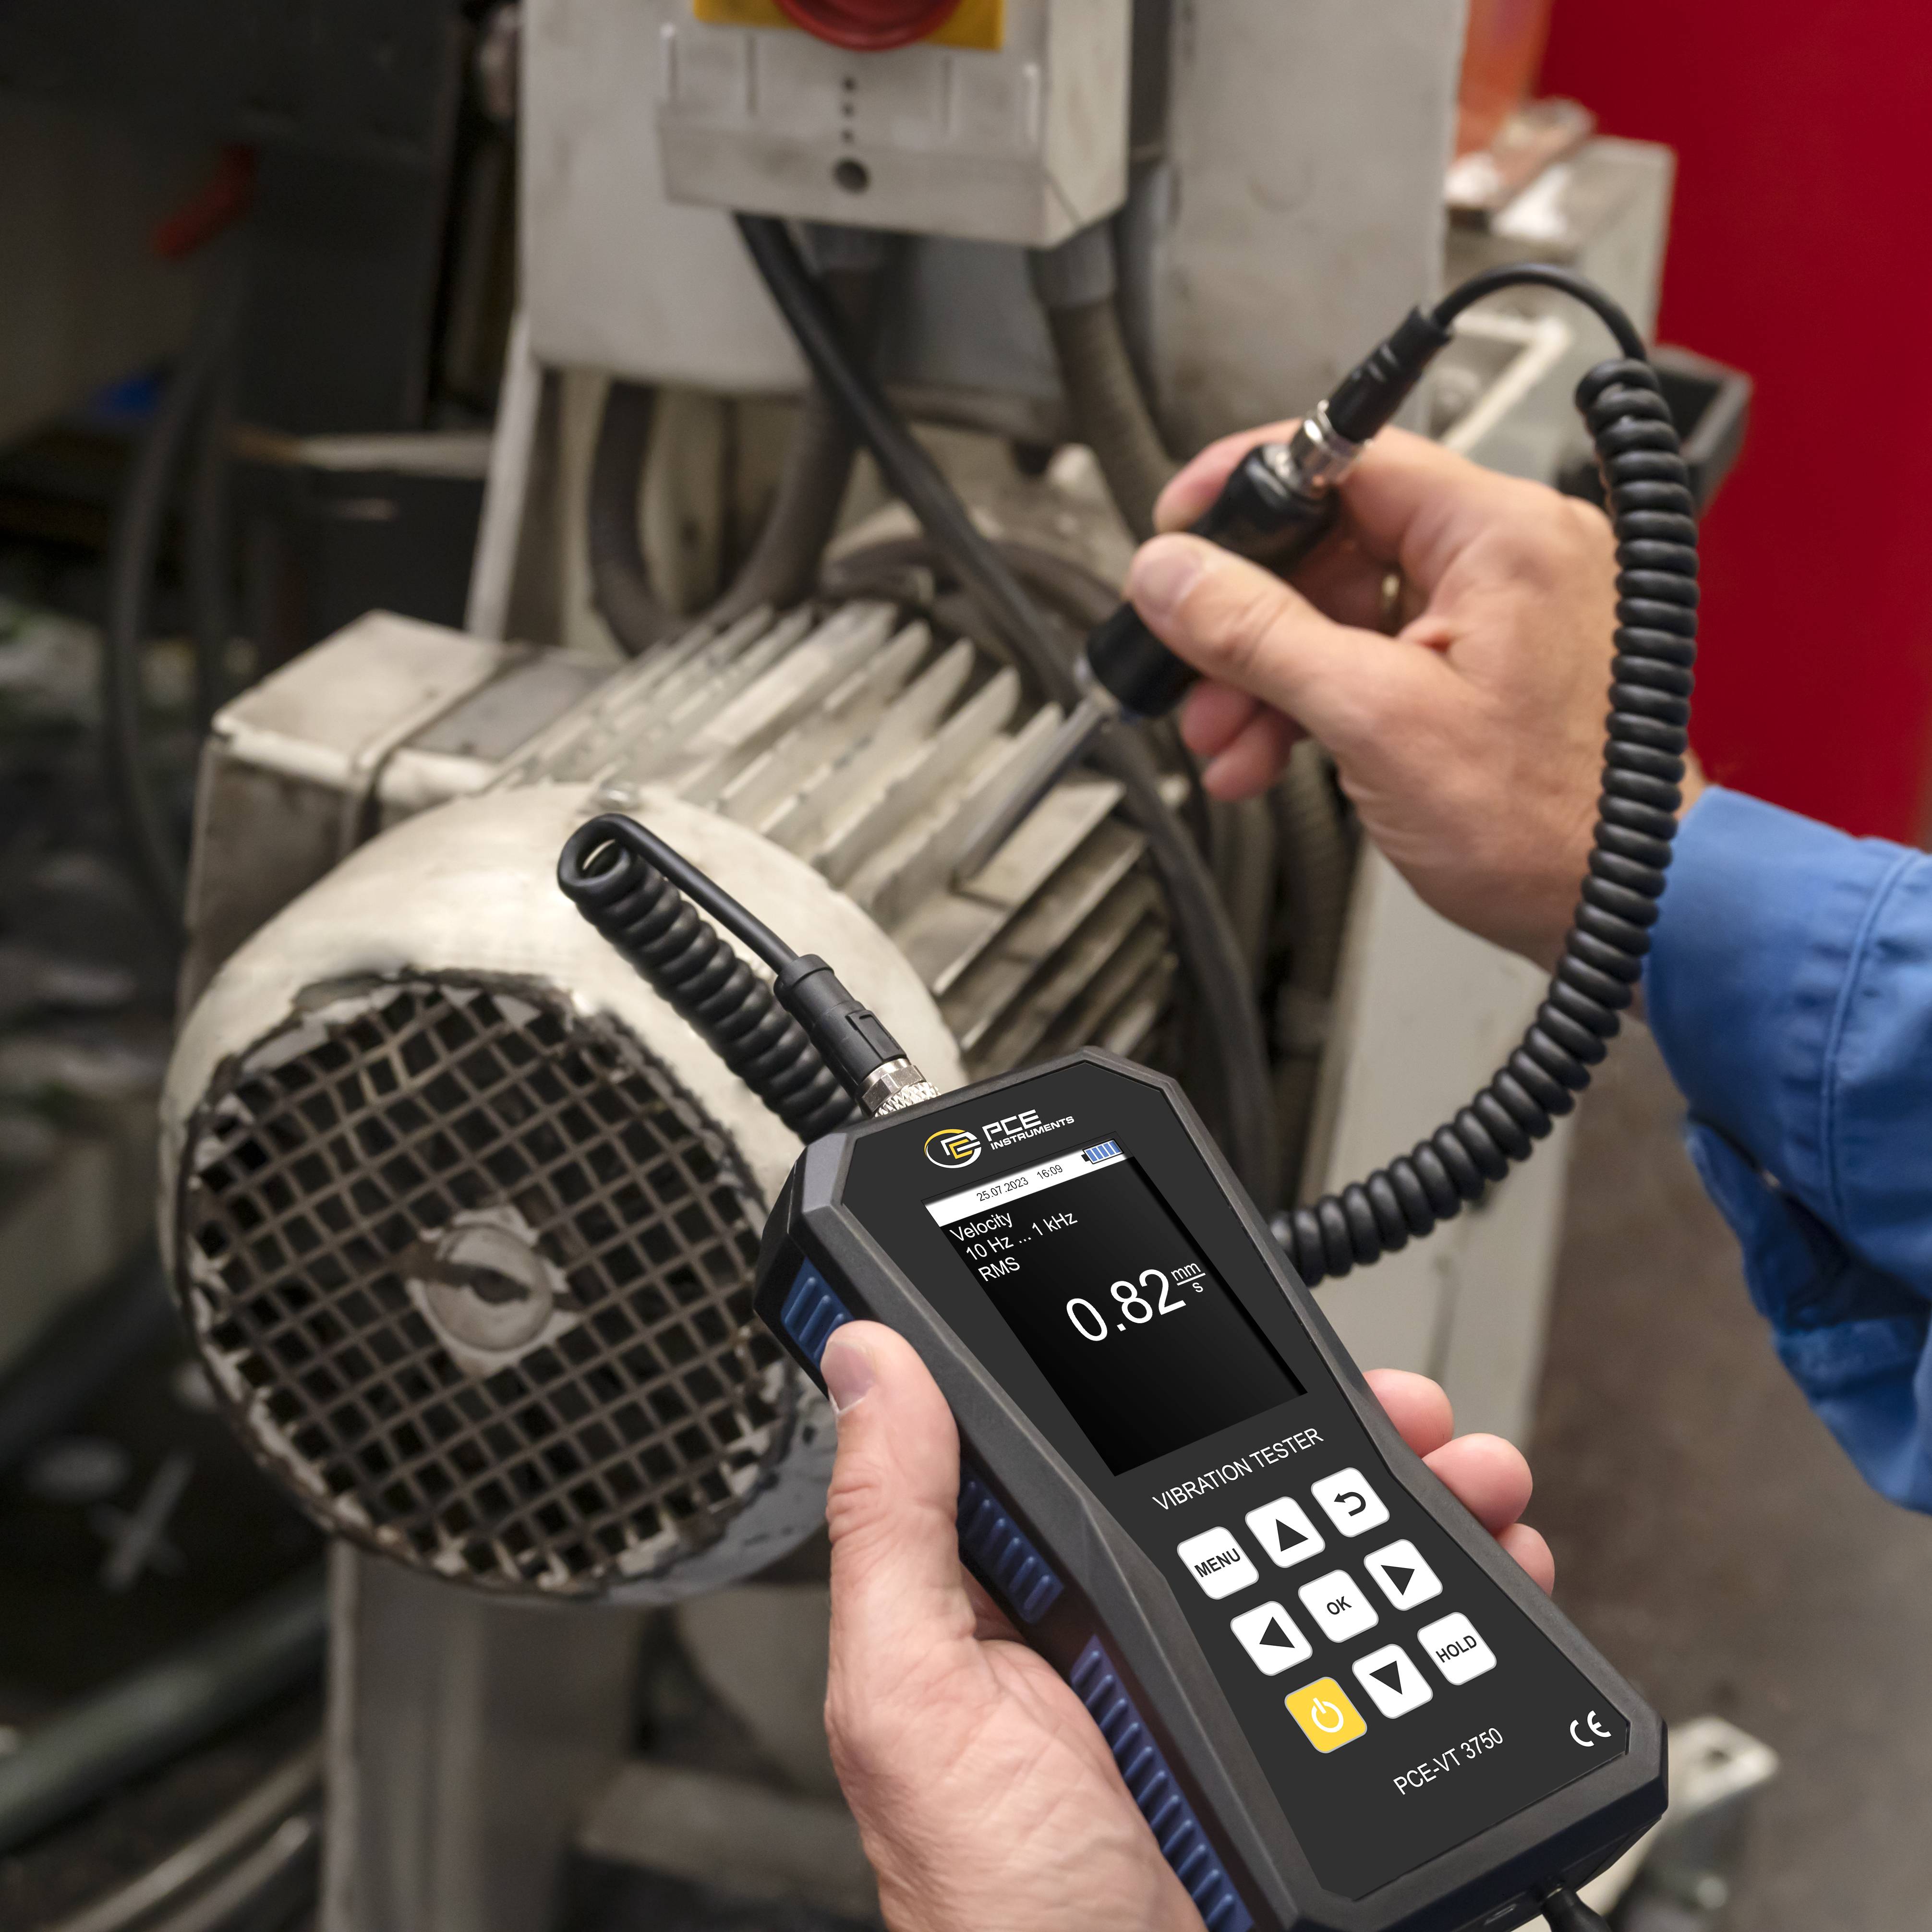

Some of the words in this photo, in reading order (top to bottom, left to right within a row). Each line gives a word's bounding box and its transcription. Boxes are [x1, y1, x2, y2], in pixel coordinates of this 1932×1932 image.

[982, 1109, 1042, 1141] PCE
[990, 1116, 1075, 1150] INSTRUMENTS
[976, 1177, 1029, 1202] 25.07.2023
[1037, 1164, 1063, 1180] 16:09
[950, 1212, 1013, 1242] Velocity
[966, 1244, 988, 1260] 10
[987, 1235, 1014, 1252] Hz
[1032, 1222, 1044, 1236] 1
[1043, 1211, 1078, 1232] kHz
[978, 1257, 1021, 1281] RMS
[1171, 1263, 1201, 1281] mm
[1066, 1269, 1186, 1342] 0.82
[1152, 1458, 1253, 1510] VIBRATION
[1249, 1428, 1324, 1468] TESTER
[1194, 1548, 1241, 1578] MENU
[1327, 1596, 1352, 1615] OK
[1436, 1635, 1478, 1663] HOLD
[1393, 1748, 1461, 1795] PCE-VT
[1460, 1727, 1504, 1760] 3750
